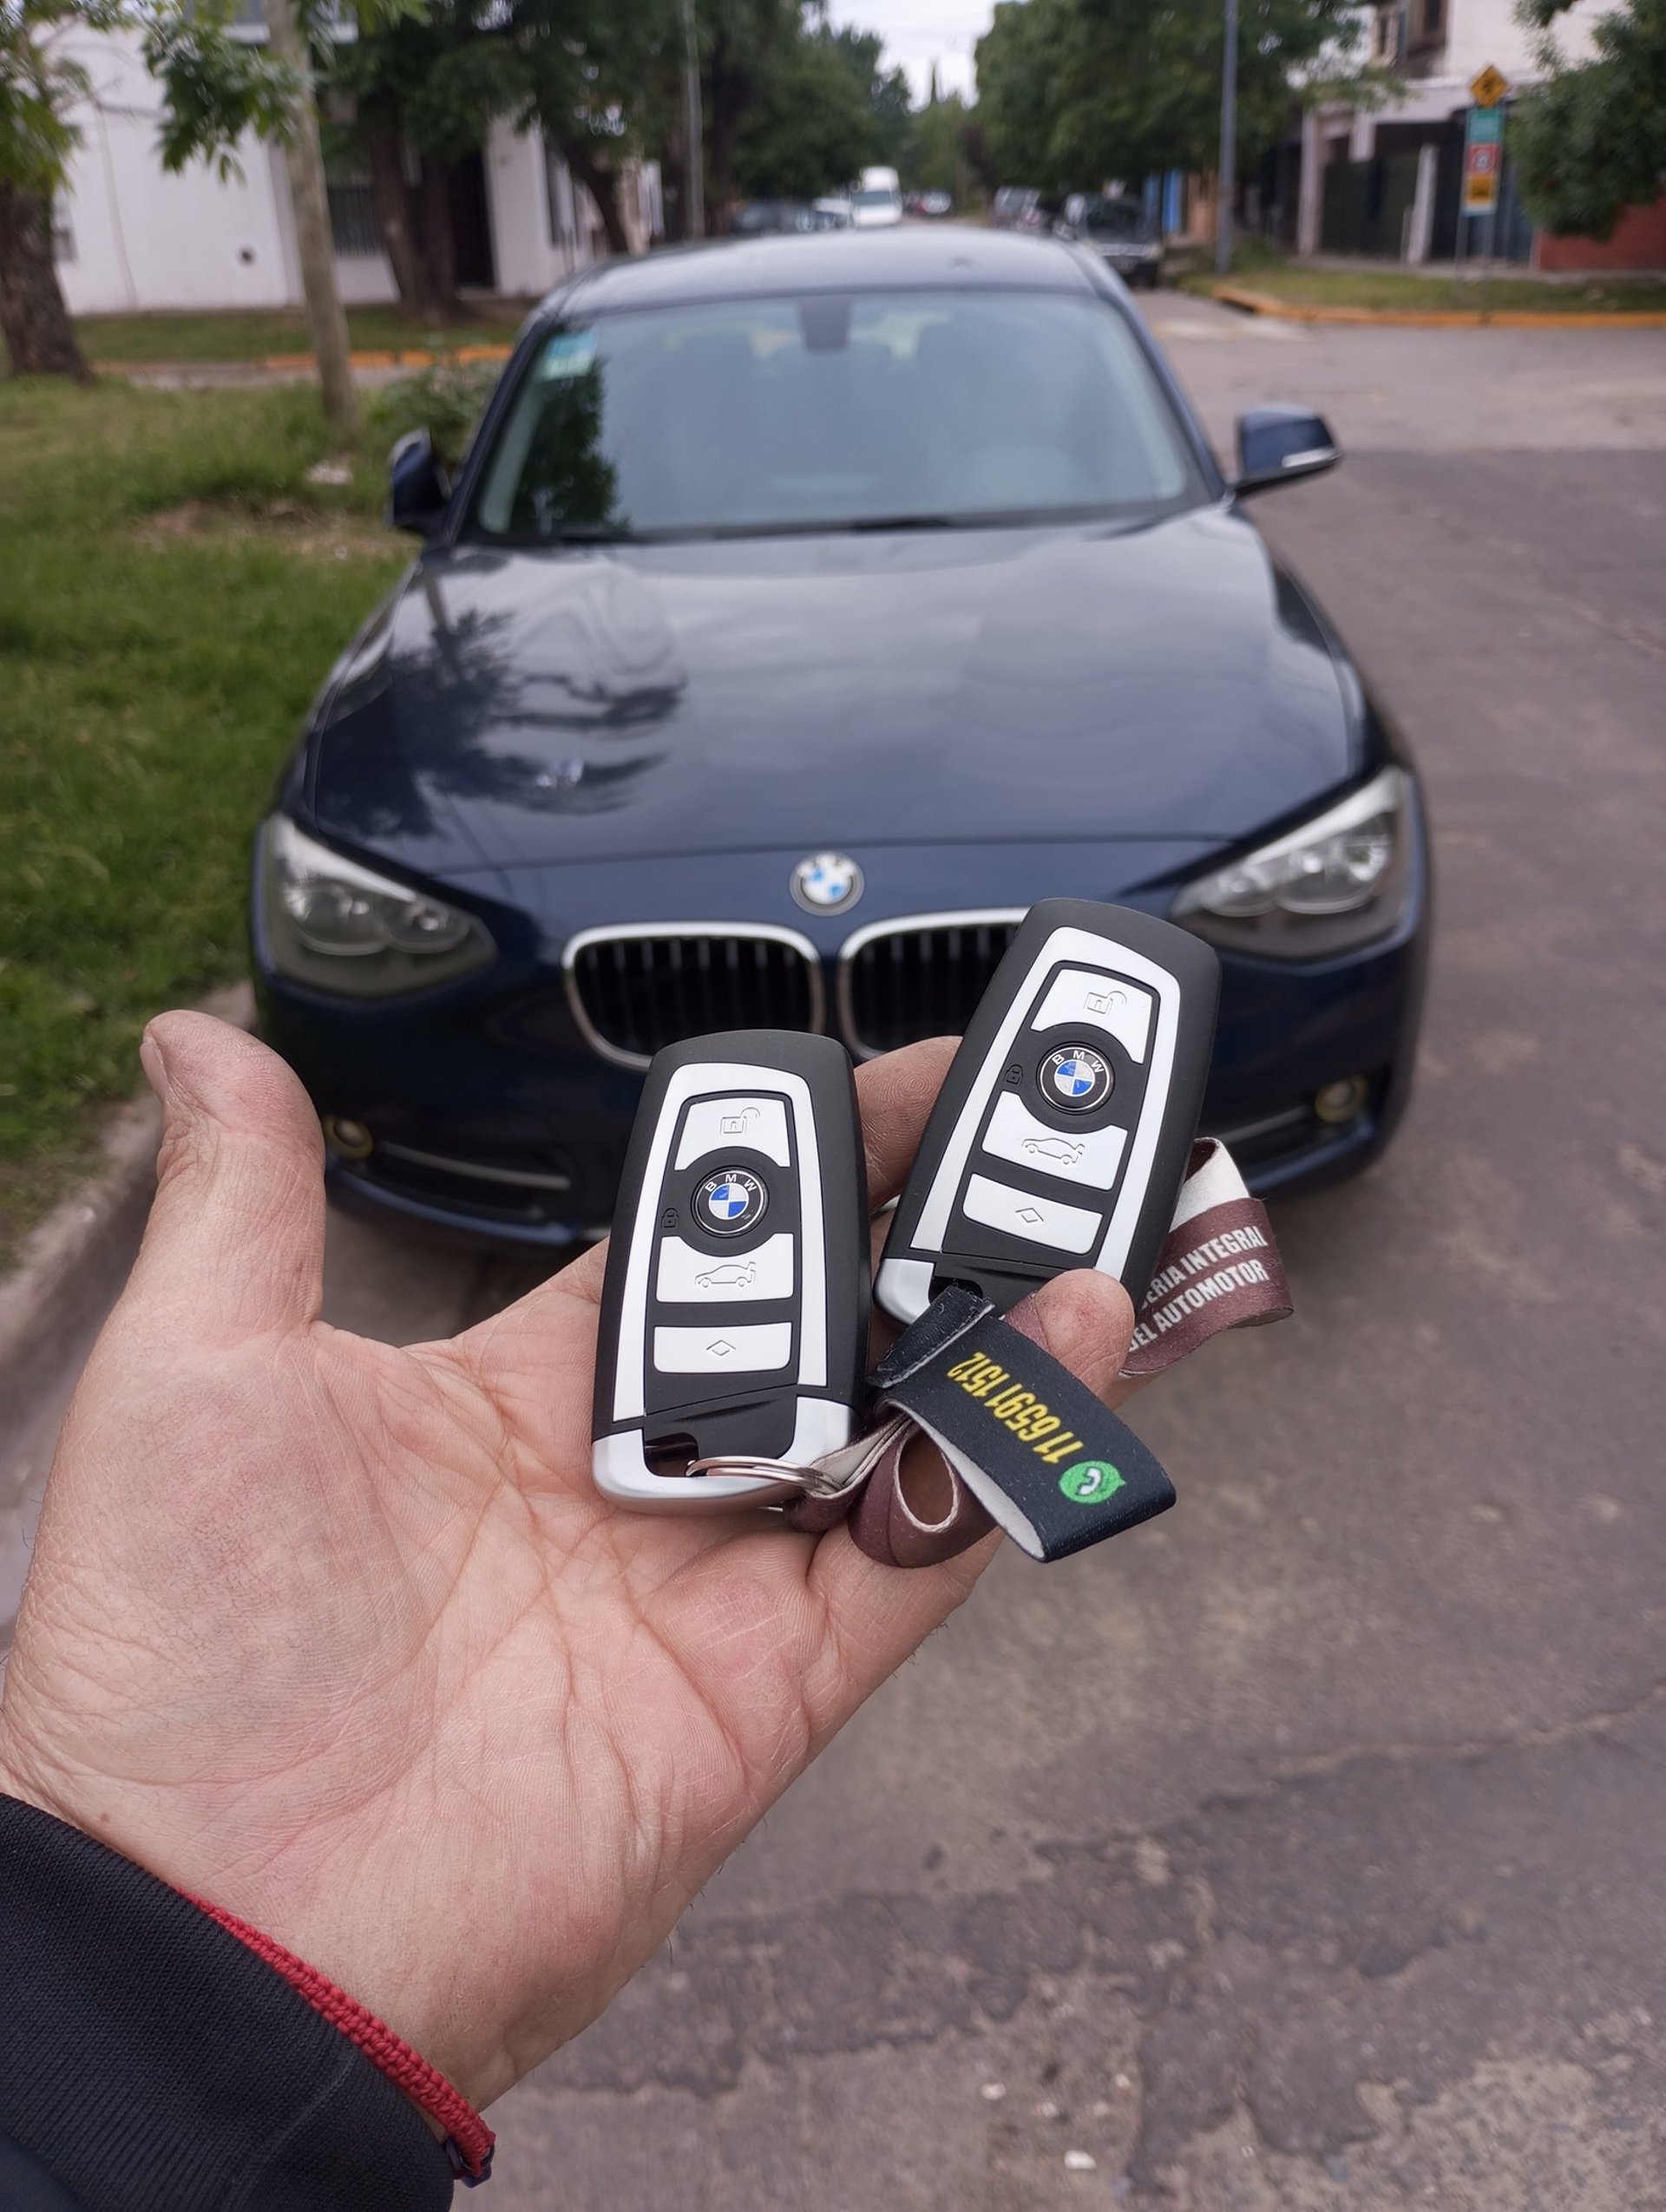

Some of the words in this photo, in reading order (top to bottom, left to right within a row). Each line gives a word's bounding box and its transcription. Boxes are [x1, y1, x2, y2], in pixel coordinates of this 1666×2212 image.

[1052, 1050, 1105, 1073] BMW
[705, 1174, 758, 1192] BMW
[1140, 1266, 1187, 1311] ERIA
[1180, 1225, 1269, 1275] INTEGRAL
[1152, 1259, 1270, 1333] AUTOMOTOR
[947, 1351, 1011, 1397] 1512
[984, 1384, 1061, 1442] 6591
[1033, 1431, 1084, 1464] 11
